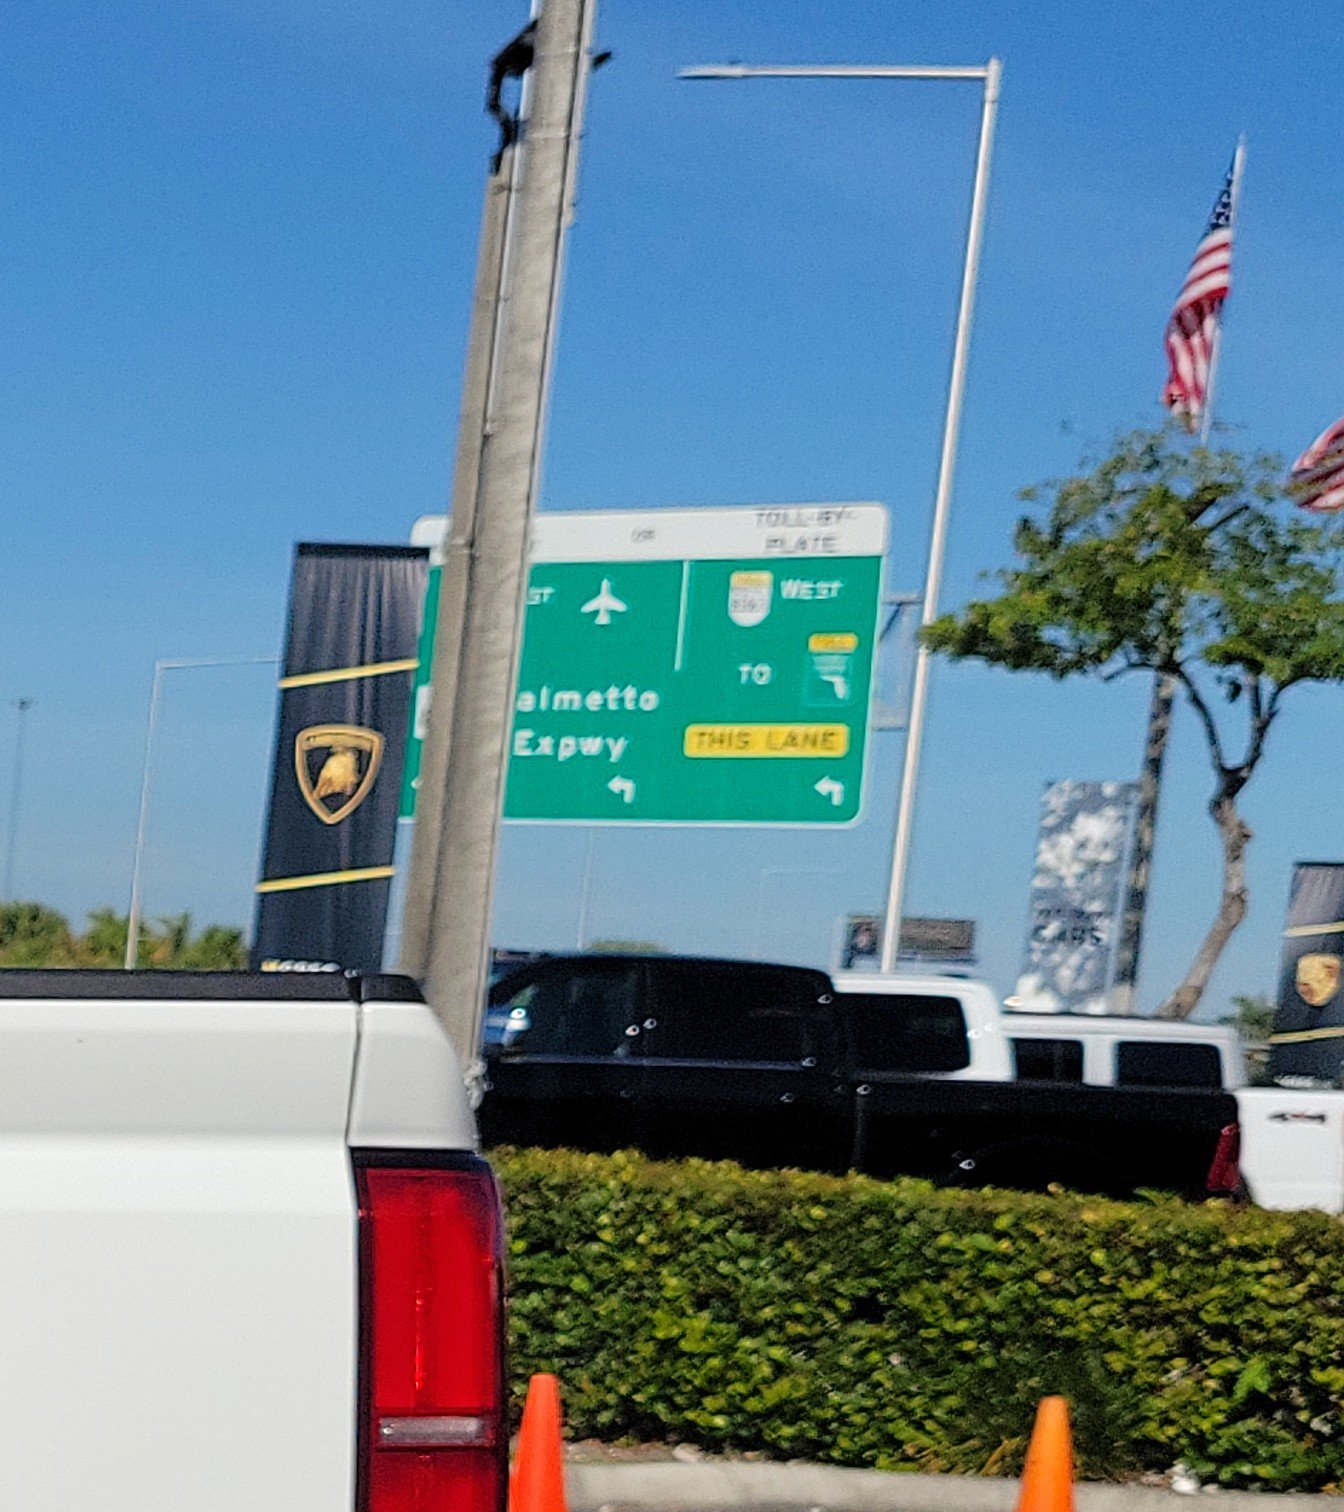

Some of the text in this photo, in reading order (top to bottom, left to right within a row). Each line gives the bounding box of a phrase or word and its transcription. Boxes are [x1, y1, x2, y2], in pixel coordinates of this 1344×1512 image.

[738, 662, 773, 686] TO
[516, 683, 660, 713] almetto
[513, 728, 629, 763] Expwy
[696, 729, 838, 752] THIS LANE
